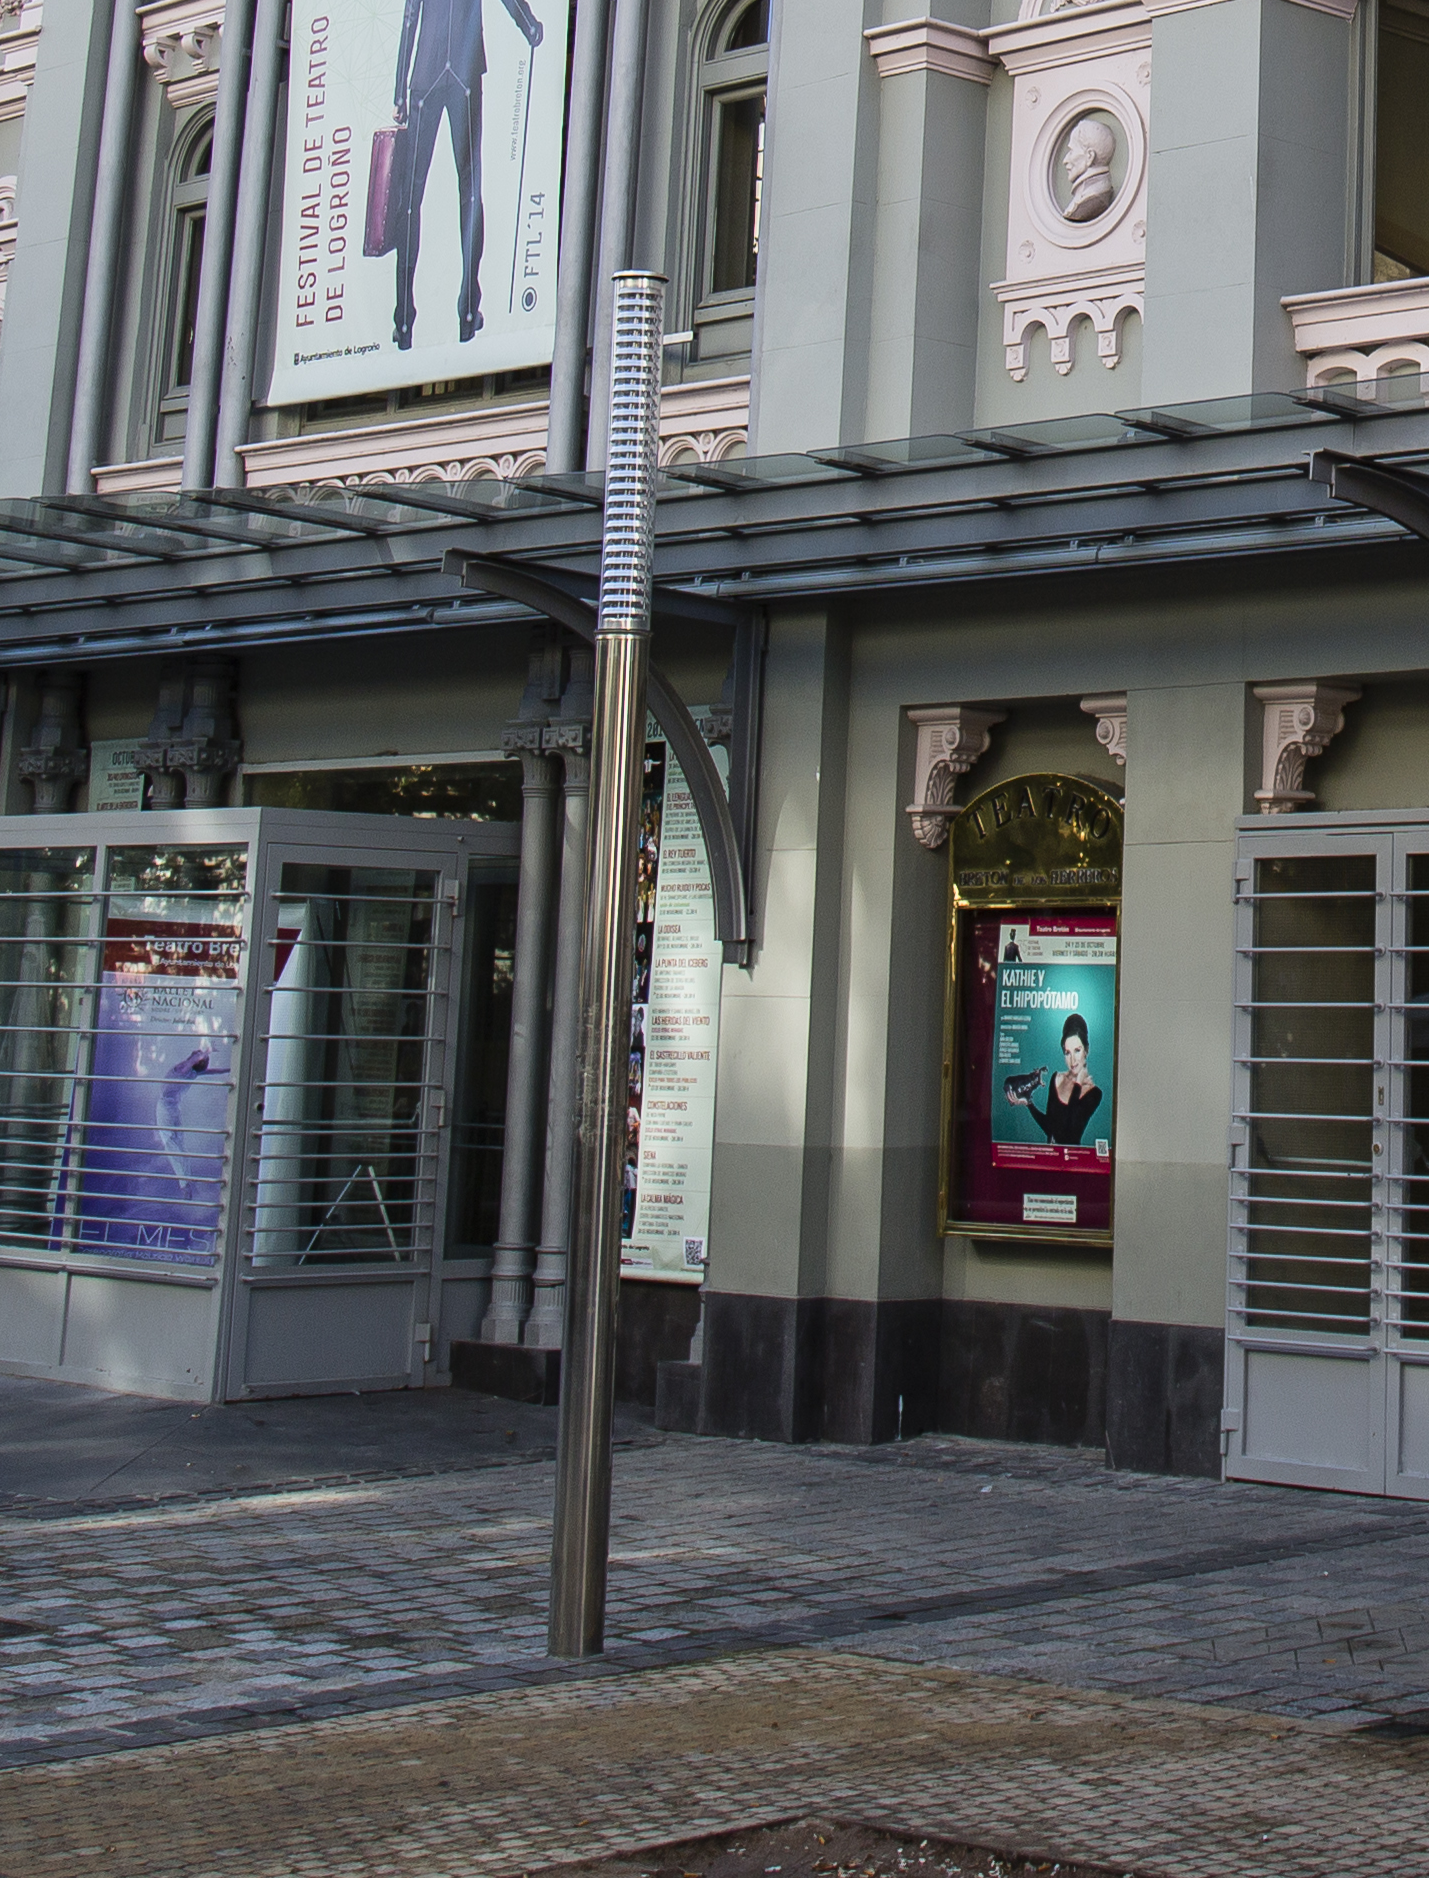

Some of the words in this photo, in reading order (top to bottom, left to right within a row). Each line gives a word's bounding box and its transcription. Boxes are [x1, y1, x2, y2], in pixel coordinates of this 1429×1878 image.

[305, 15, 330, 128] TEATRO
[510, 59, 526, 162] www.teatrobreton.org
[303, 134, 324, 174] DE
[327, 125, 352, 274] LOGROÑO
[295, 182, 322, 328] FESTIVAL
[325, 282, 345, 324] DE
[300, 349, 342, 364] Ayuntamiento
[344, 346, 352, 356] de
[353, 341, 381, 355] Logroño
[967, 785, 1112, 840] TEATRO
[960, 870, 1009, 886] BRETON
[1050, 868, 1118, 885] HERREROS
[144, 935, 203, 953] Teatro
[1002, 969, 1037, 987] KATHIE
[1038, 969, 1045, 987] Y
[152, 996, 215, 1009] NACIONAL
[1001, 990, 1012, 1008] EL
[1013, 987, 1079, 1010] HIPOPÓTAMO
